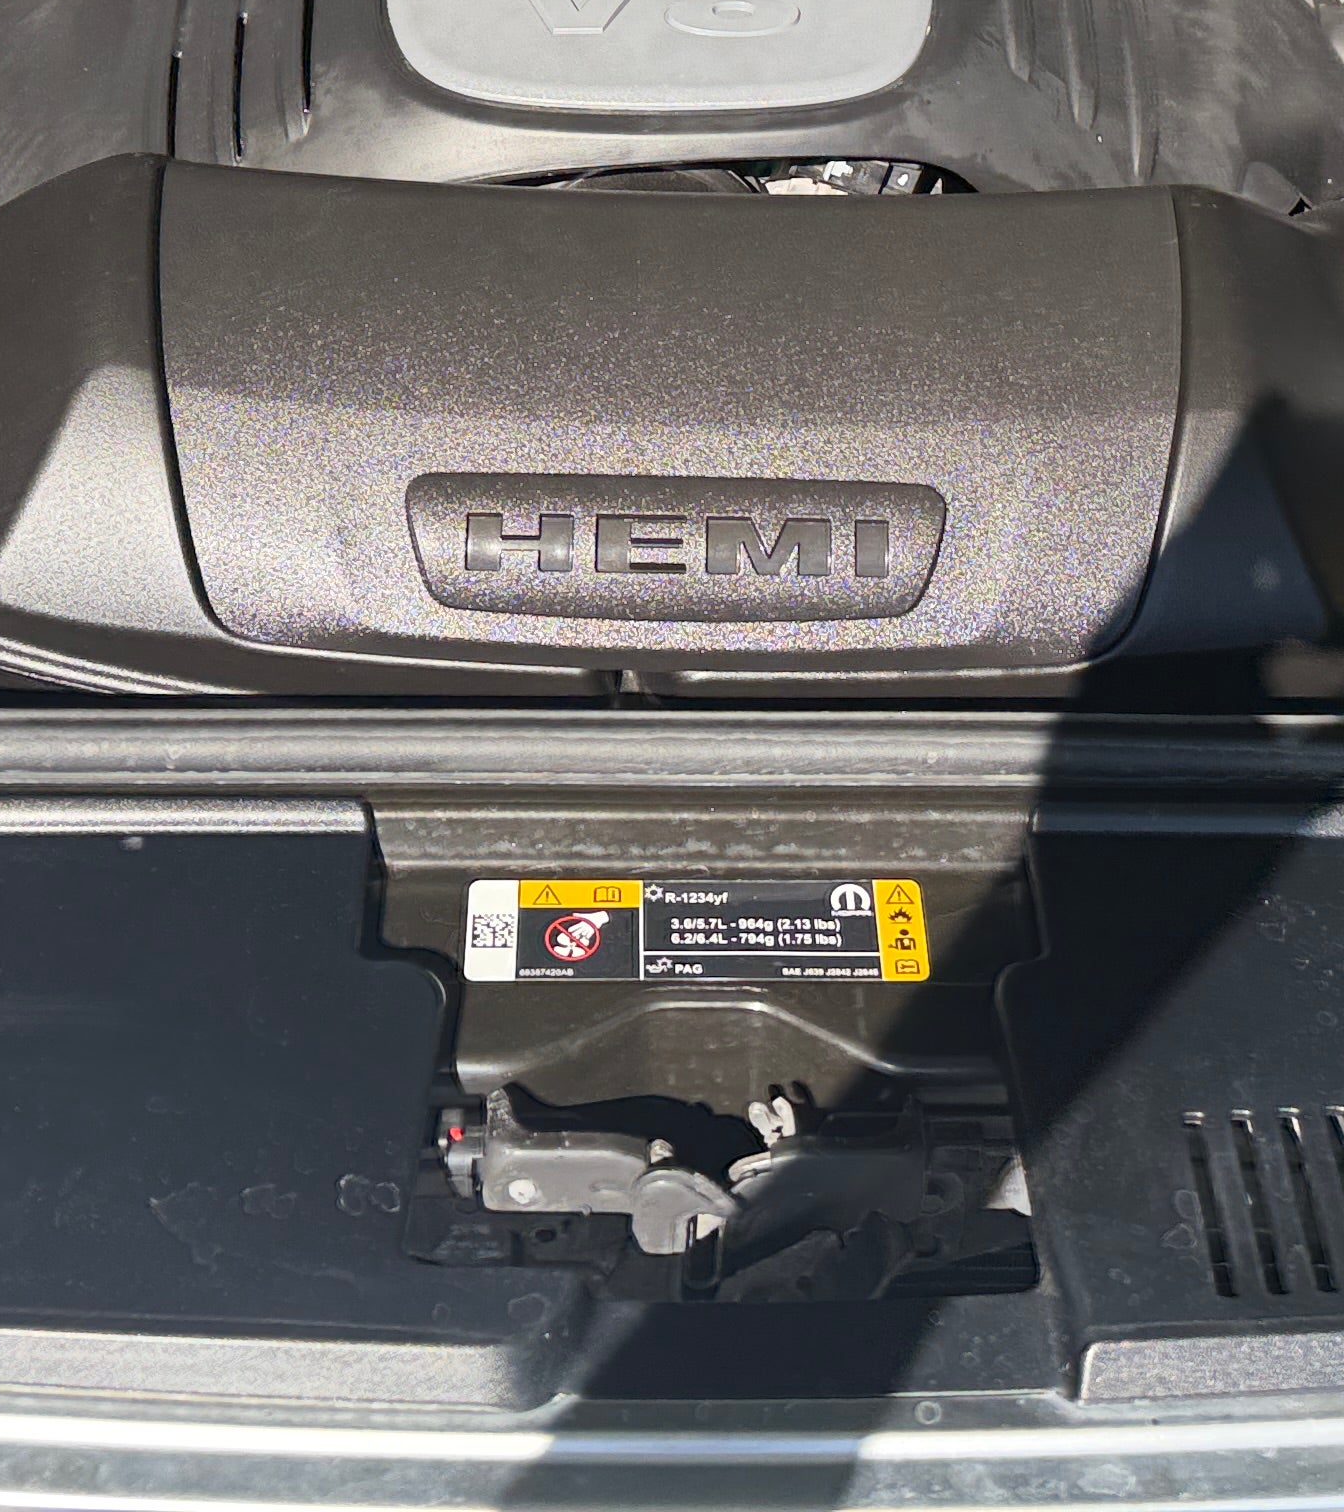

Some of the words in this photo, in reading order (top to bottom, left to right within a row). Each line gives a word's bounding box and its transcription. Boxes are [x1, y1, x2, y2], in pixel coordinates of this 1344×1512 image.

[465, 512, 890, 577] HEMI
[665, 891, 728, 907] R-1234yf
[738, 918, 774, 932] 964g
[777, 918, 812, 933] (2.13
[814, 918, 841, 933] lbs)
[671, 933, 728, 946] 6.2/6.4L
[740, 933, 775, 947] 794g
[778, 933, 813, 948] (1.75
[815, 933, 843, 948] lbs)
[674, 963, 703, 975] PAG
